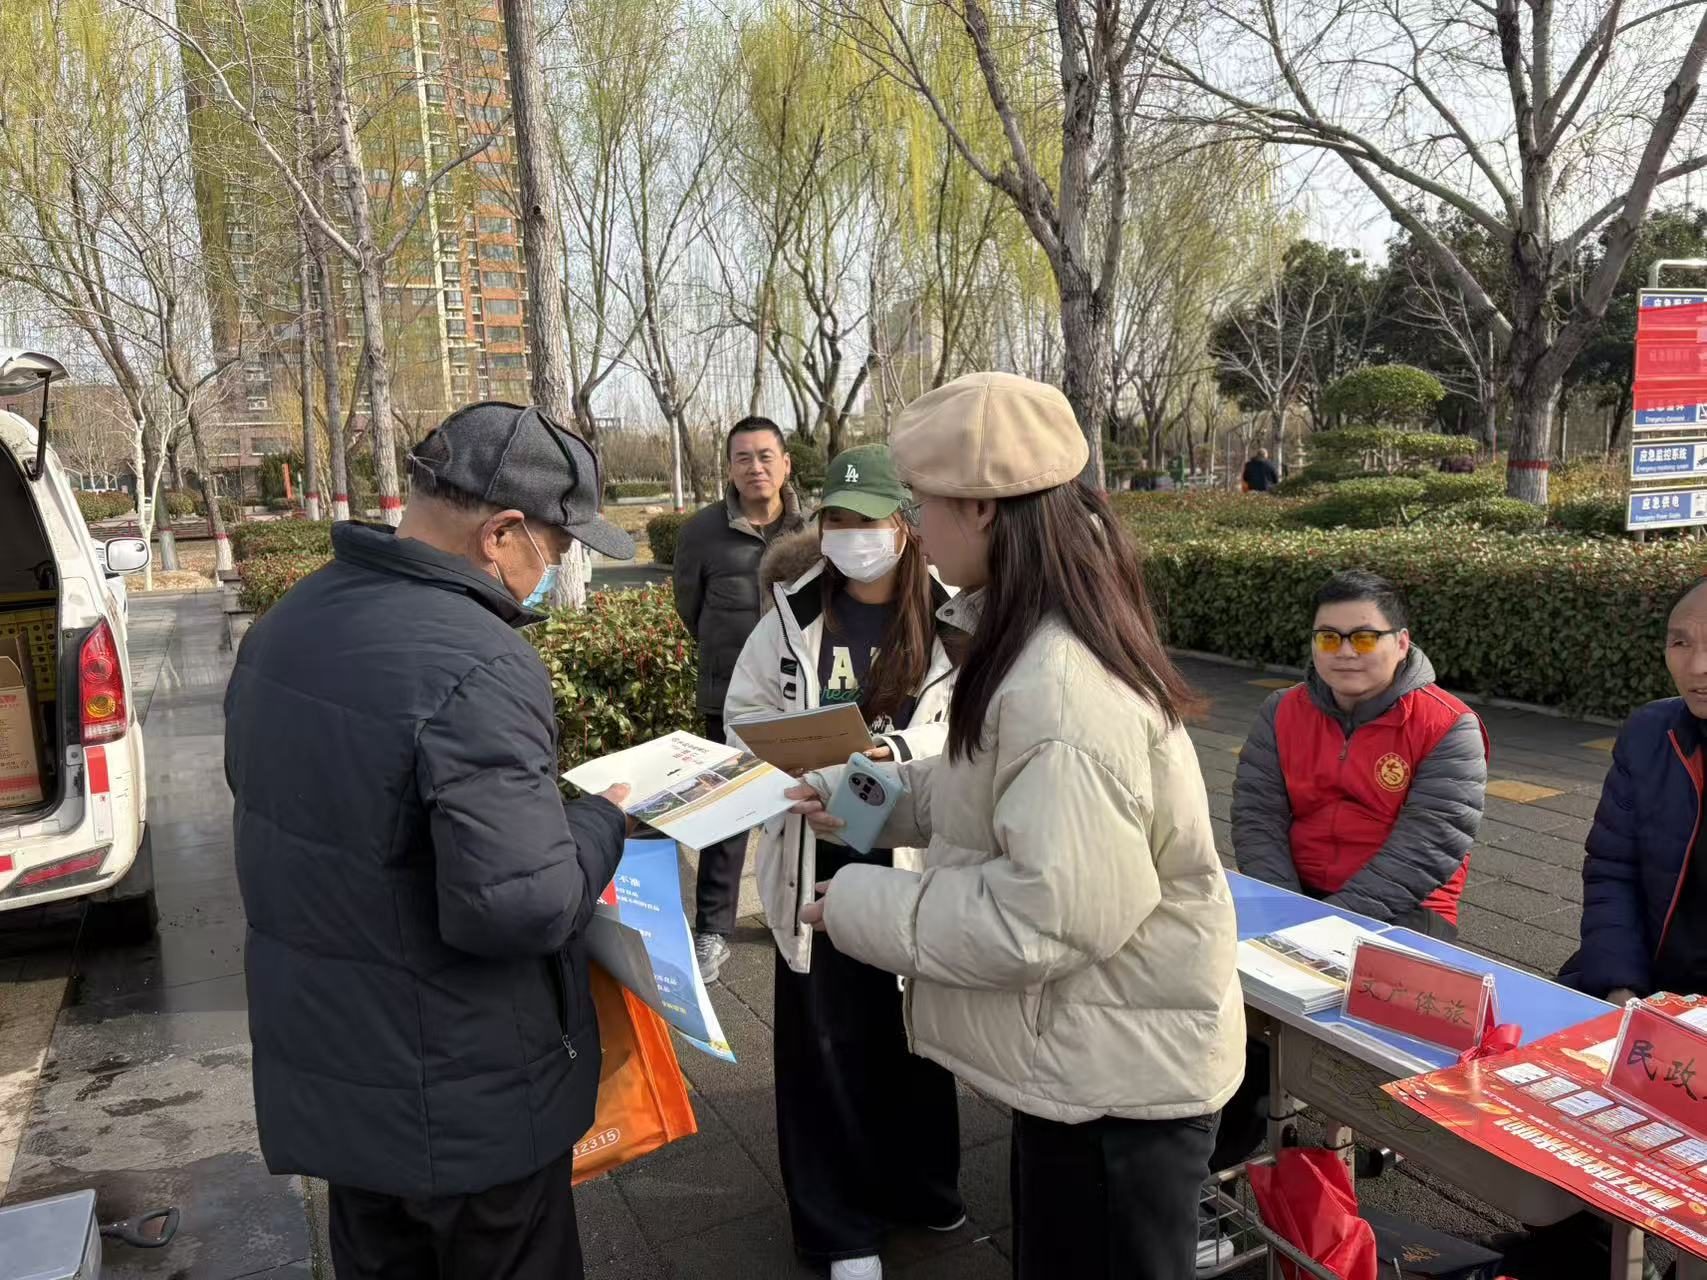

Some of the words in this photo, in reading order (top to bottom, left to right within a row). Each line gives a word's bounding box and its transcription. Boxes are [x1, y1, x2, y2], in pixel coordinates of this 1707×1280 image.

[1639, 447, 1687, 462] 应急监控系统
[845, 464, 859, 483] LA
[1641, 495, 1680, 510] 应急供电
[1357, 974, 1472, 1026] 文广体旅
[1627, 1039, 1707, 1102] 民政
[573, 1130, 616, 1156] 12315
